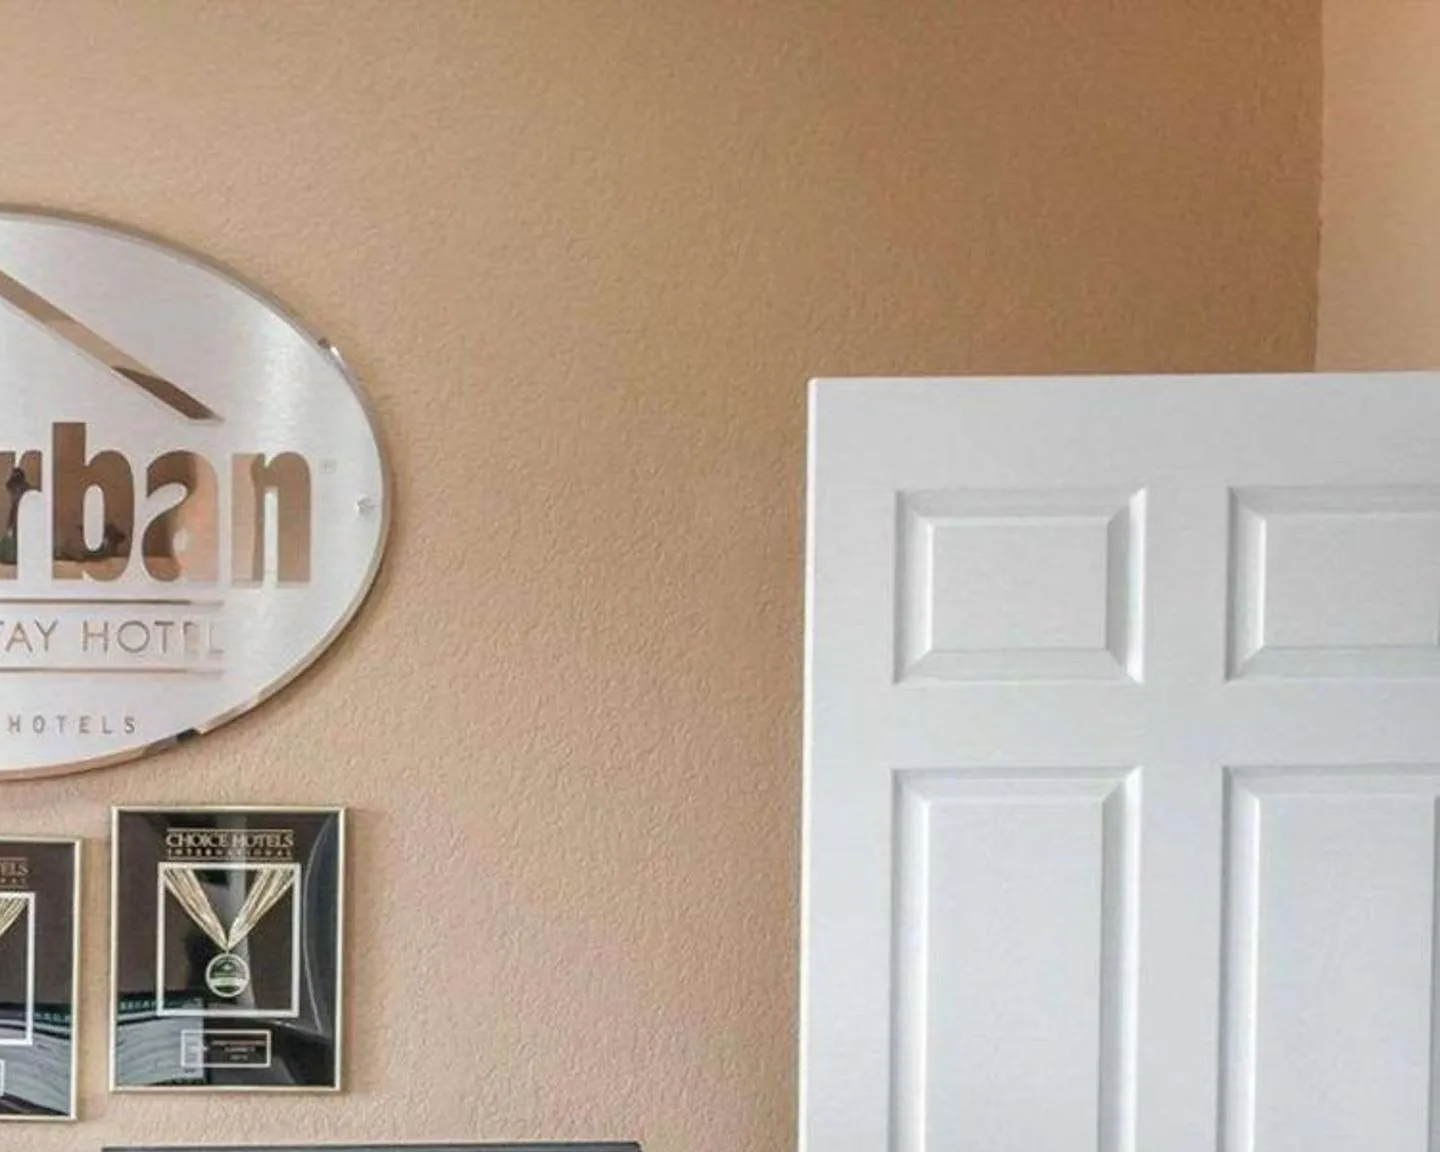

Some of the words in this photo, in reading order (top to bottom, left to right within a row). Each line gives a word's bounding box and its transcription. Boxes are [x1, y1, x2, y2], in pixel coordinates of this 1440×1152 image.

[82, 619, 225, 654] HOTEL
[8, 715, 137, 735] HOTELS
[166, 832, 228, 848] CHOICE
[232, 832, 294, 848] HOTELS
